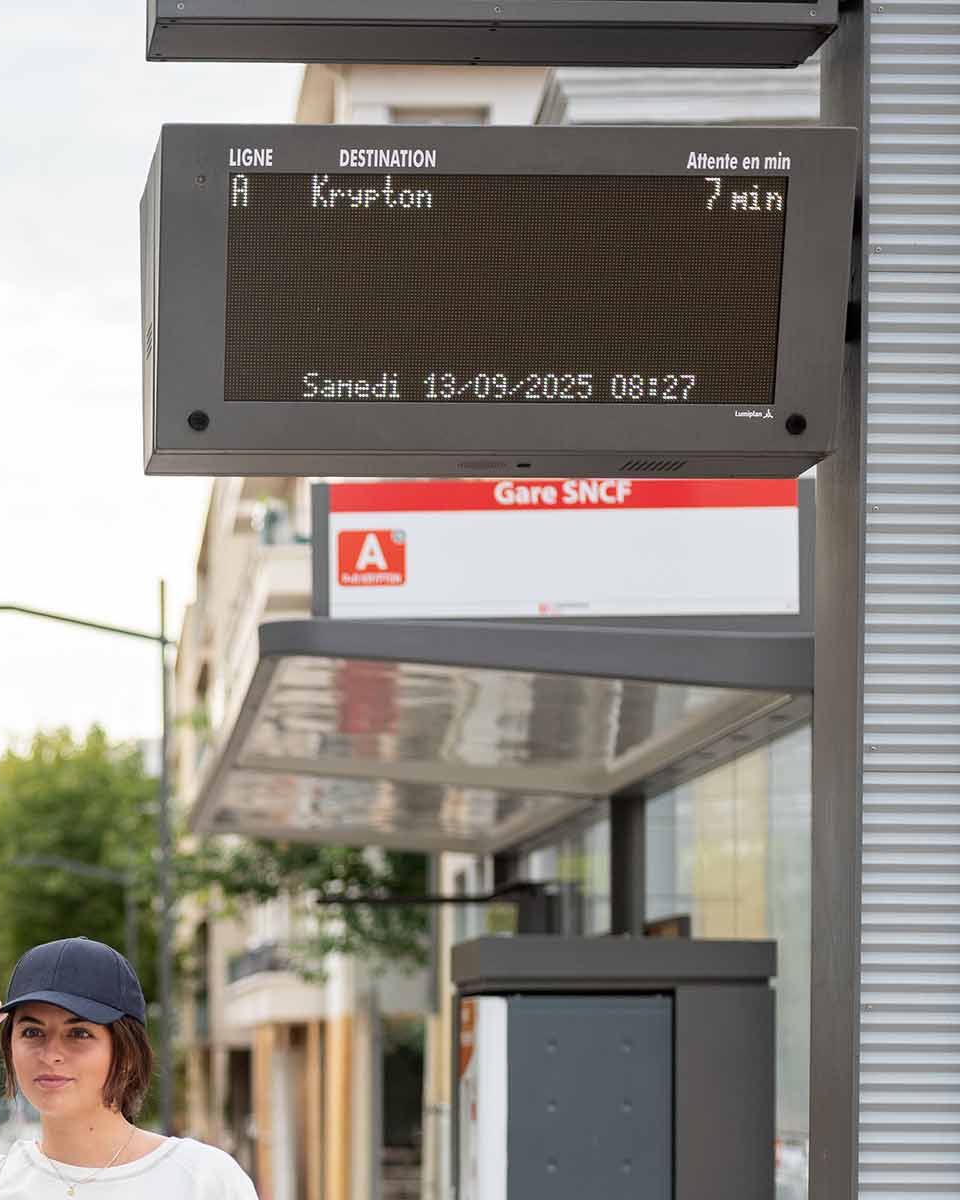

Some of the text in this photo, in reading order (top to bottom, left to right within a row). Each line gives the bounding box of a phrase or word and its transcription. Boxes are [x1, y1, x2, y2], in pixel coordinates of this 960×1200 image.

[229, 148, 273, 167] LIGNE
[339, 149, 437, 168] DESTINATION
[686, 151, 791, 170] Attente en min
[232, 174, 248, 207] A
[311, 174, 433, 208] Krypton
[704, 177, 784, 211] 7 min
[423, 373, 592, 399] 13/09/2025
[610, 374, 695, 400] 08:27
[493, 479, 632, 505] Gare SNCF
[355, 533, 389, 570] A
